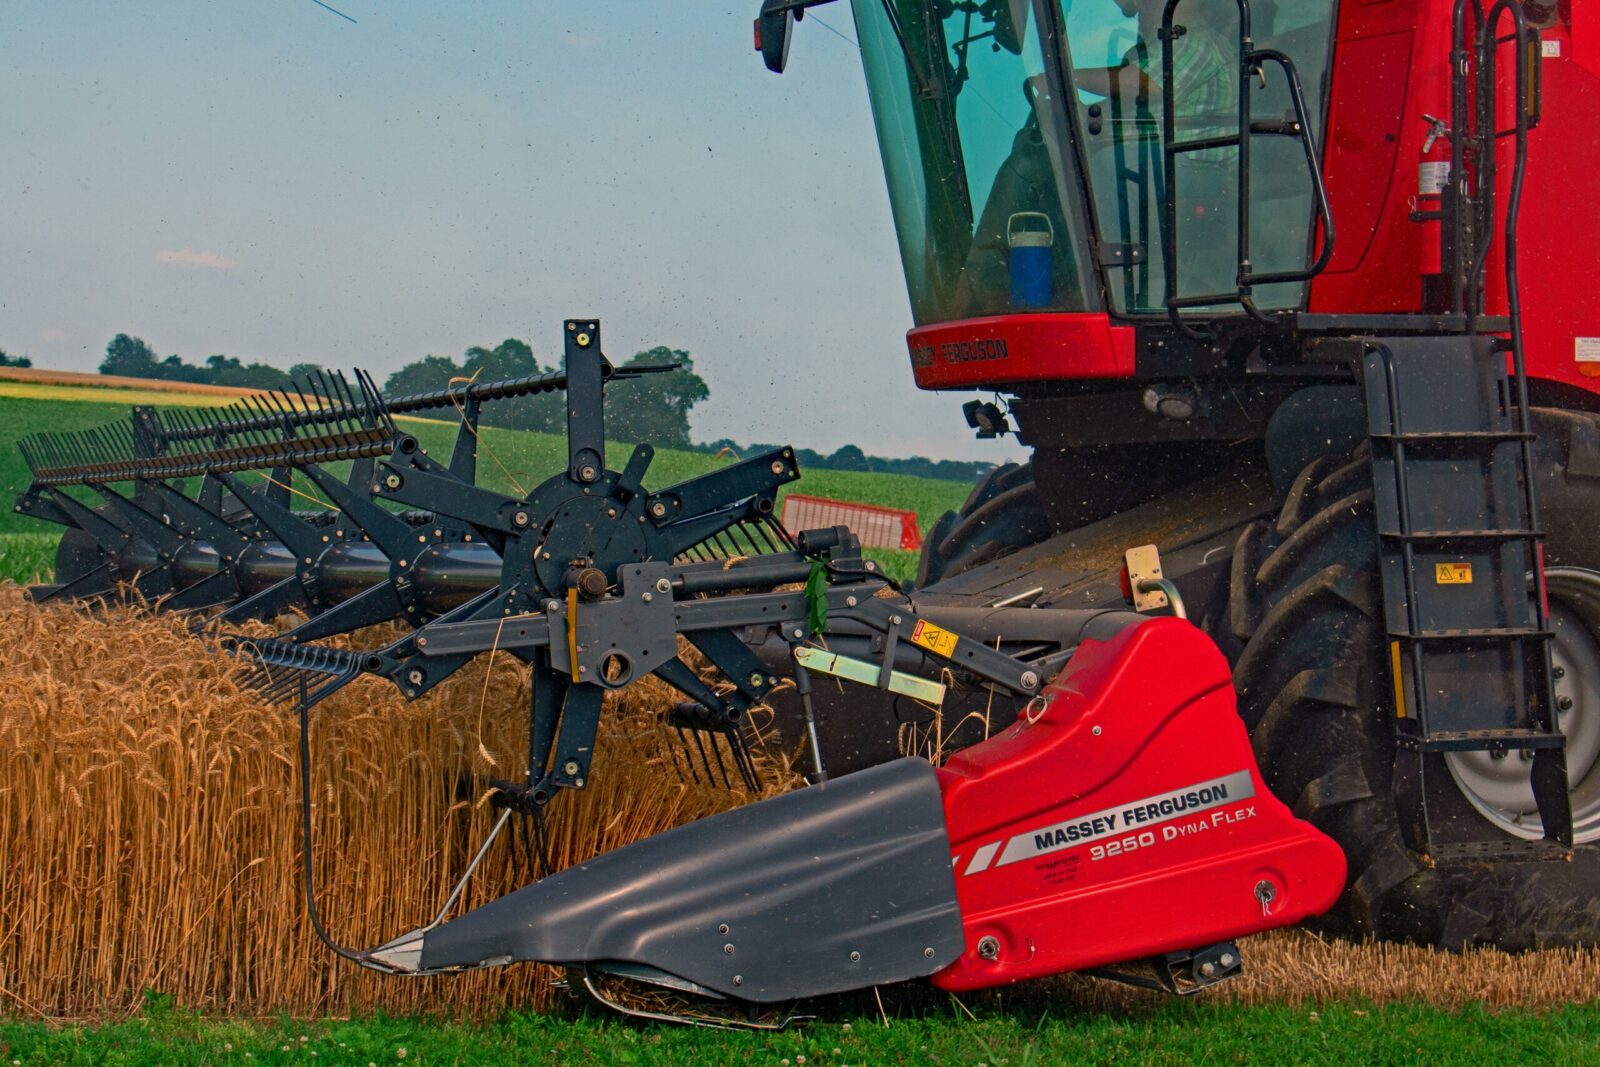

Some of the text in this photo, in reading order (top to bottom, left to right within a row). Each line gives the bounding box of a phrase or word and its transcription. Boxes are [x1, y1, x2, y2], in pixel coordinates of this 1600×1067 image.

[941, 339, 1008, 363] FERGUSON
[1035, 783, 1228, 850] MASSEY FERGUSON
[1090, 832, 1155, 861] 9250
